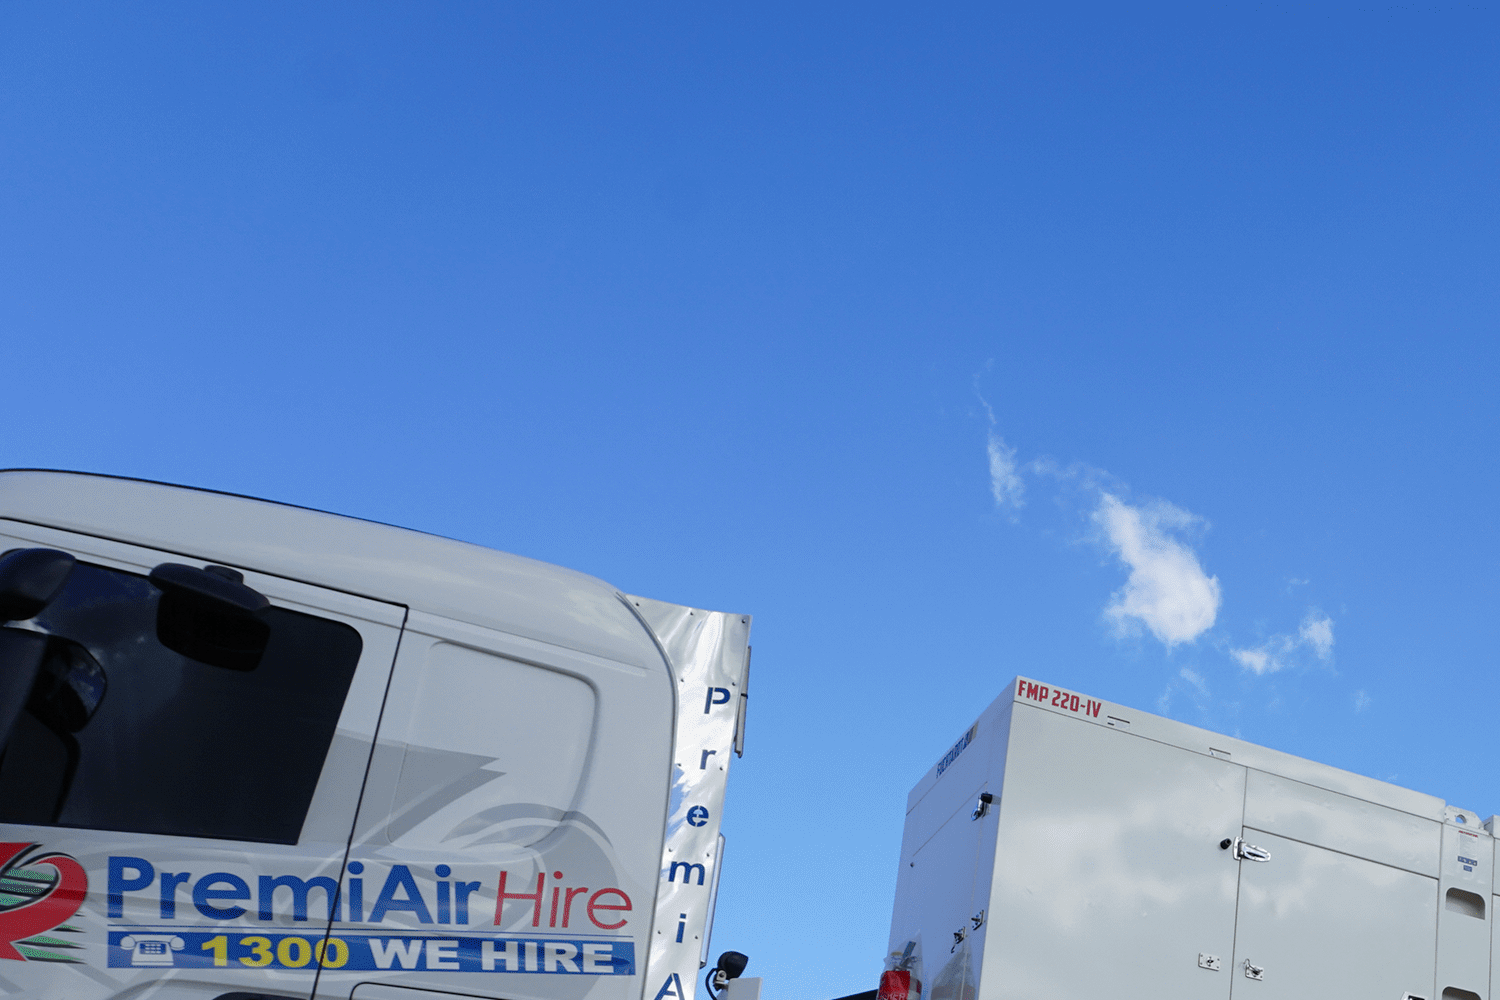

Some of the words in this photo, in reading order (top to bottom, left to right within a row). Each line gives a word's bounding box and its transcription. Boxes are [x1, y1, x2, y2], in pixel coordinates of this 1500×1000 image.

[1017, 679, 1050, 703] FMP
[1051, 689, 1102, 718] 220-IV
[493, 870, 634, 930] Hire
[200, 935, 349, 969] 1300
[370, 938, 459, 971] WE
[481, 941, 615, 974] HIRE
